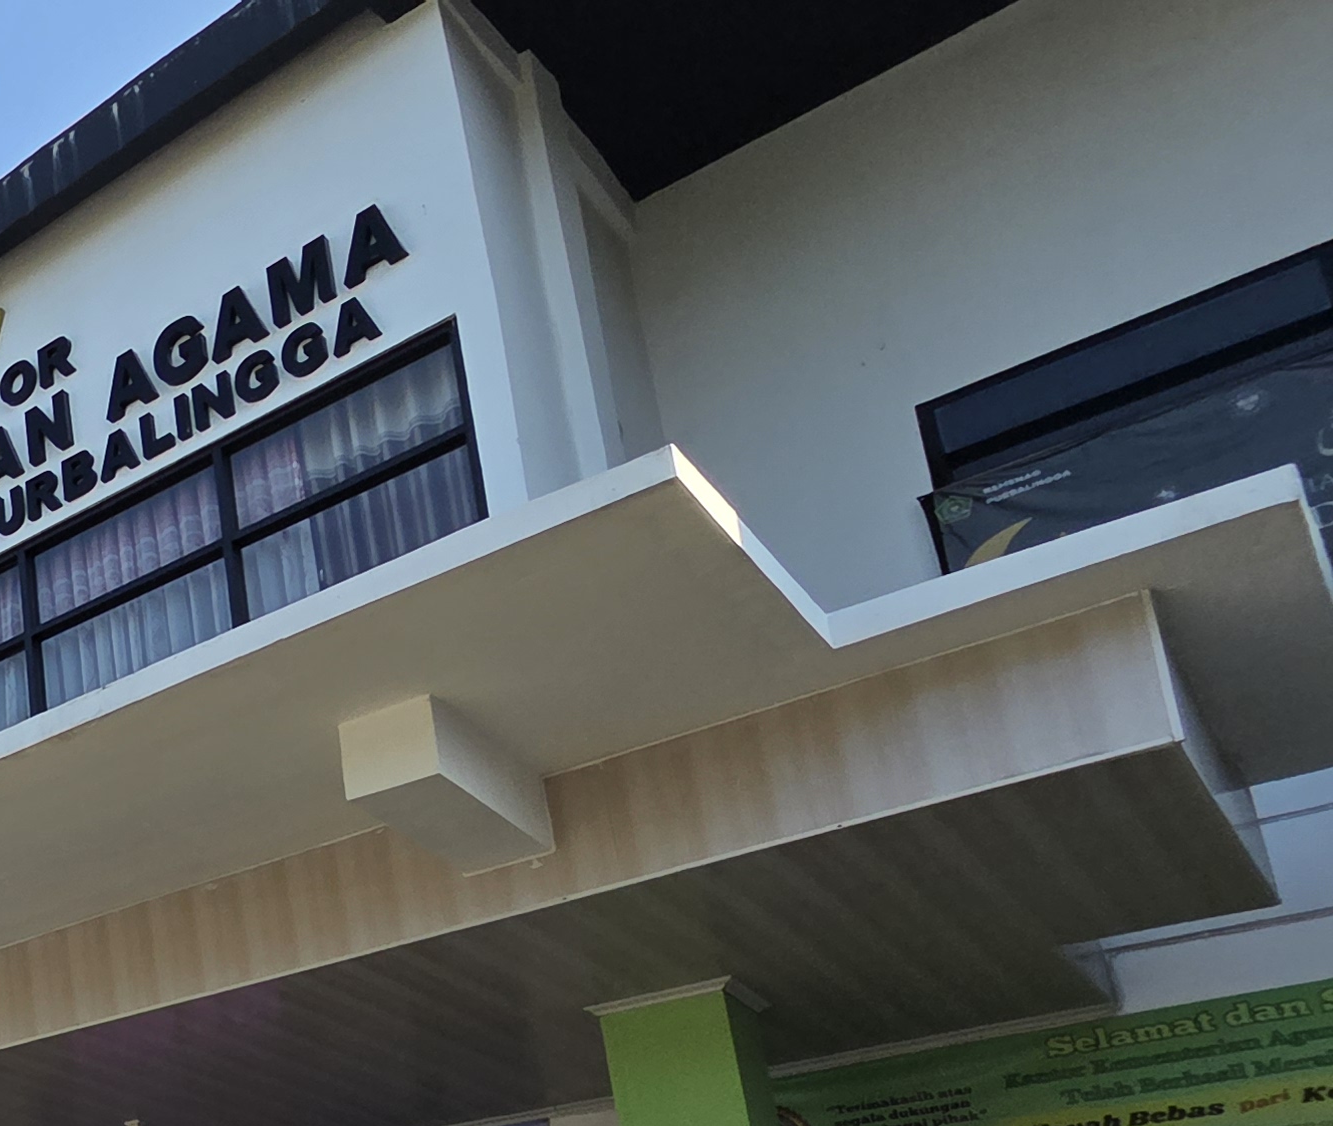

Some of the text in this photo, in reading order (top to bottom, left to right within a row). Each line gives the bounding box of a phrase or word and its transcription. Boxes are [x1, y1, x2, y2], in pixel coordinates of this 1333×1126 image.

[106, 203, 409, 422] AGAMA
[1045, 1010, 1217, 1058] Selamat
[1224, 999, 1313, 1027] dan
[888, 1099, 971, 1120] dukungan
